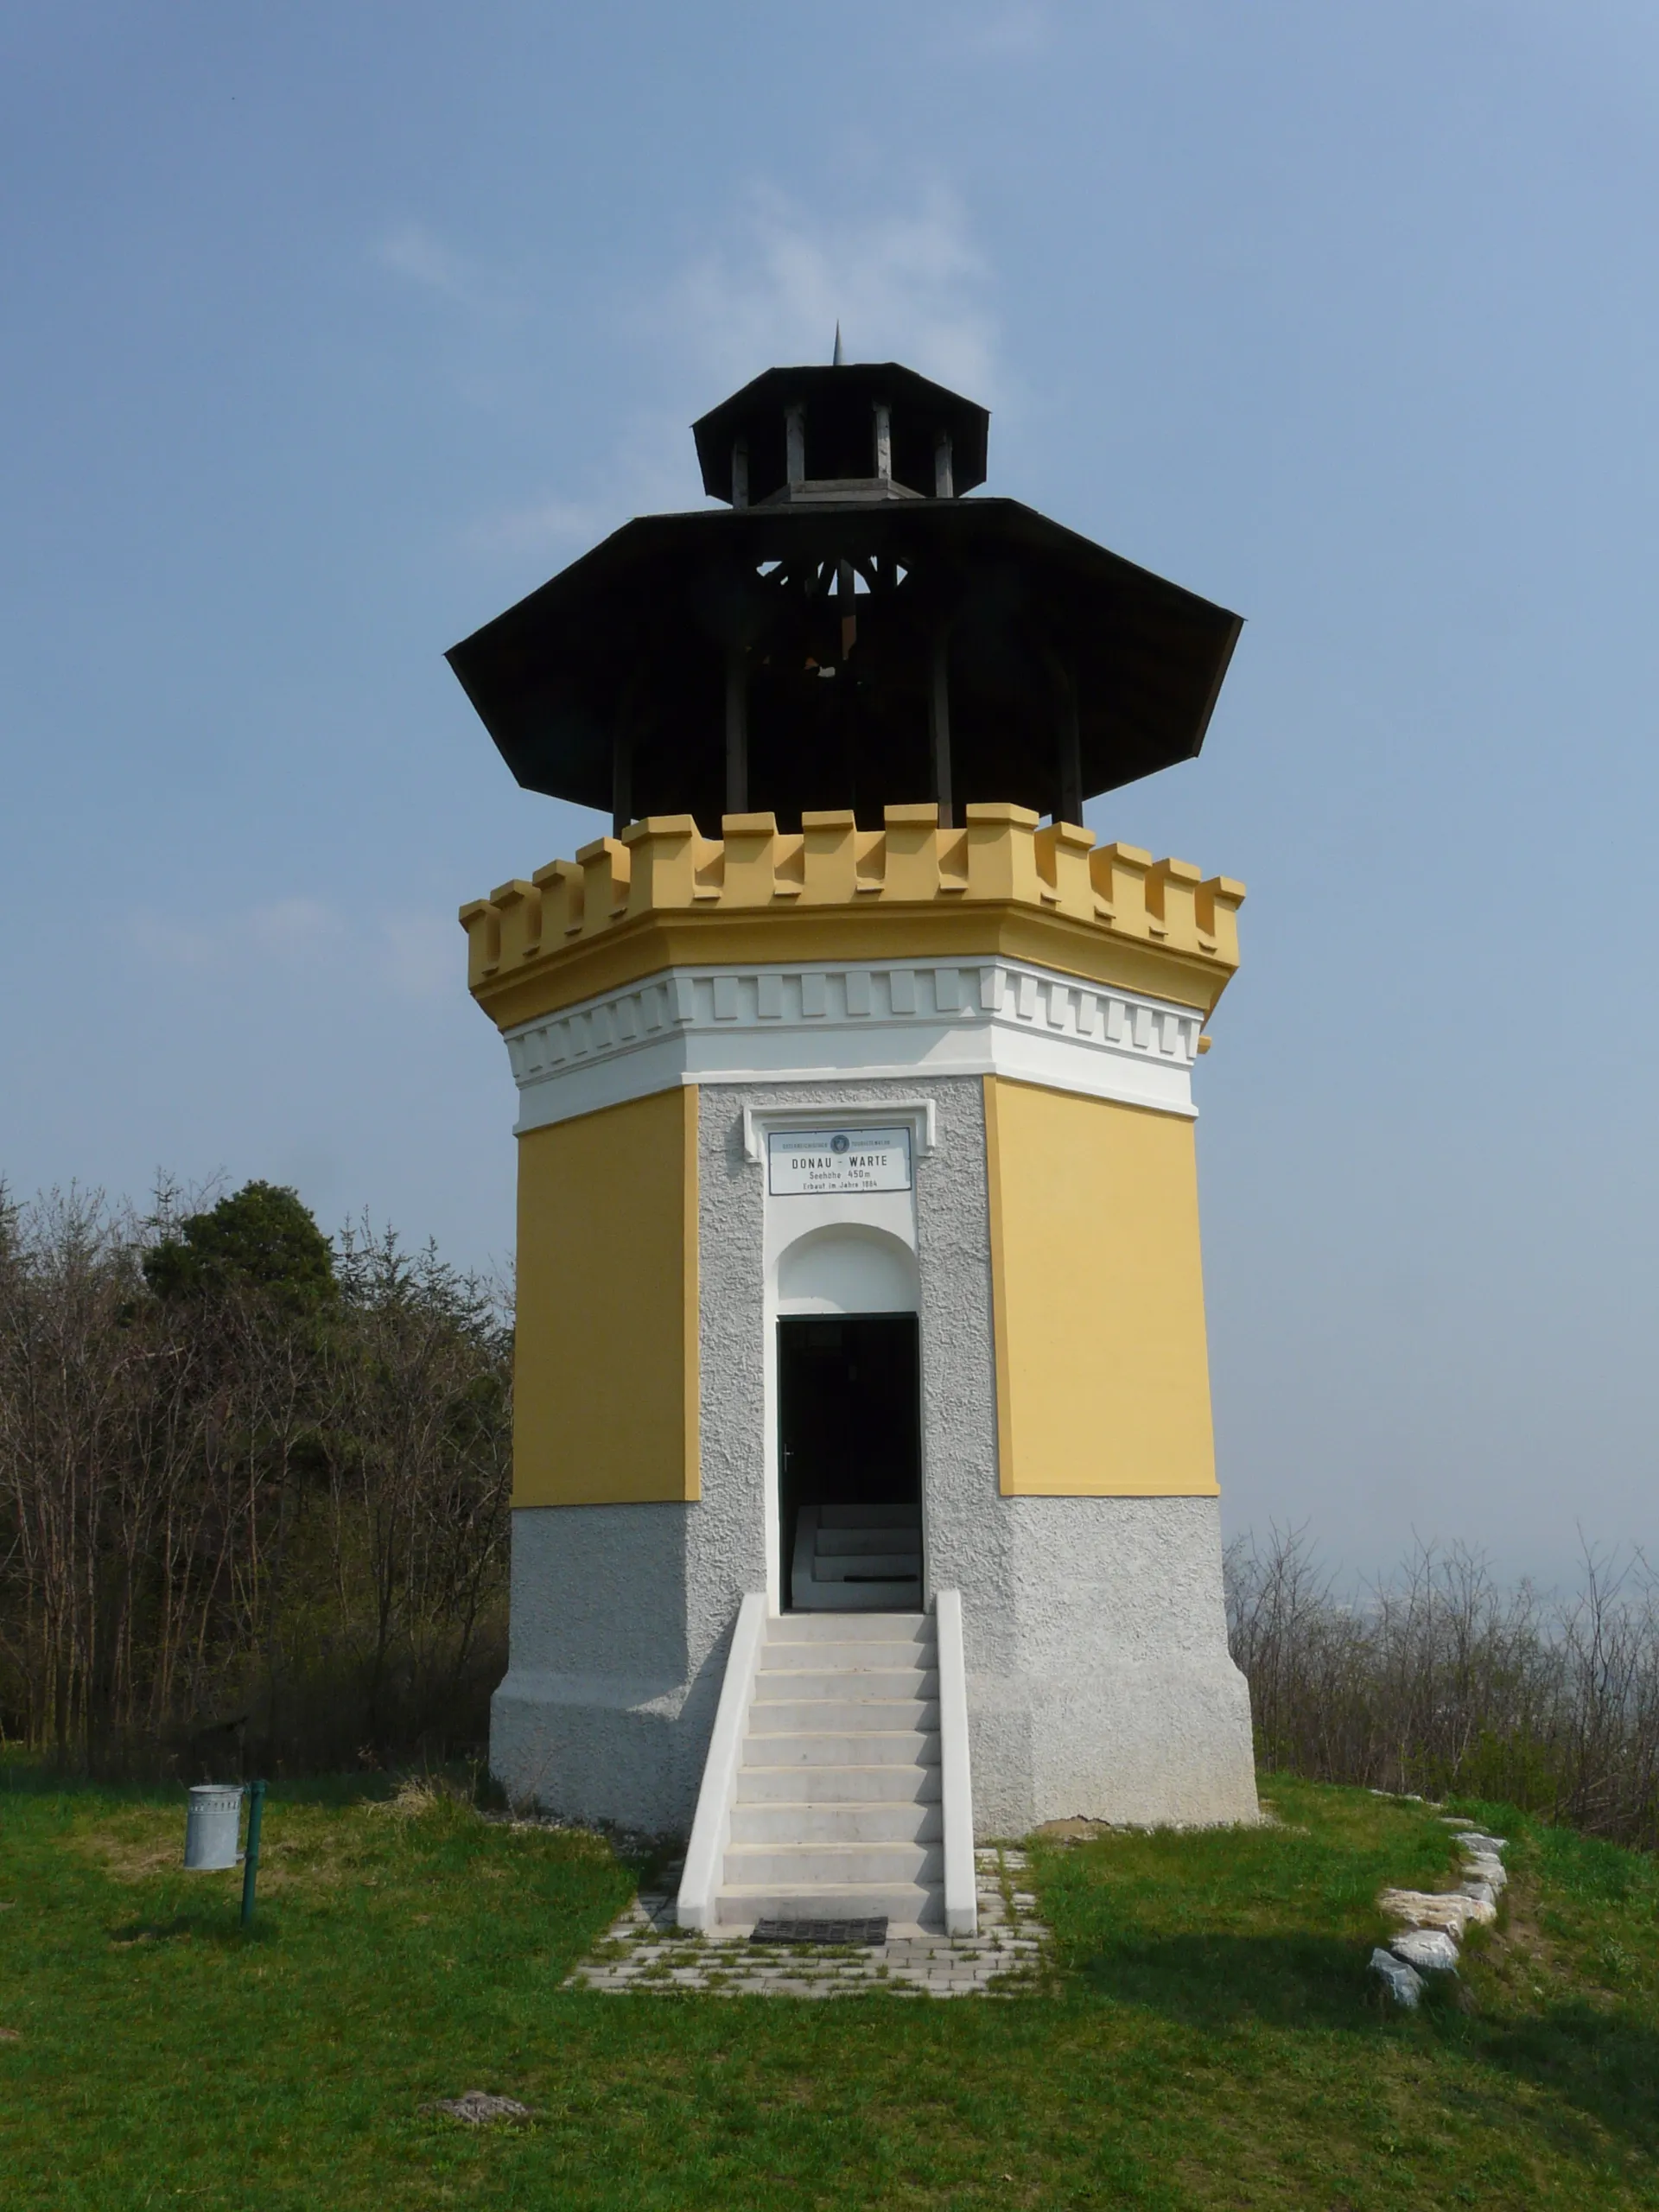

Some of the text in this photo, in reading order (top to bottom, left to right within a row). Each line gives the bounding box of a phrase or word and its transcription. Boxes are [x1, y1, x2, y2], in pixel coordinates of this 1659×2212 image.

[791, 1158, 832, 1169] DONAU
[849, 1155, 887, 1166] WARTE
[810, 1171, 842, 1179] Seehöhe
[803, 1181, 825, 1190] Erbaut
